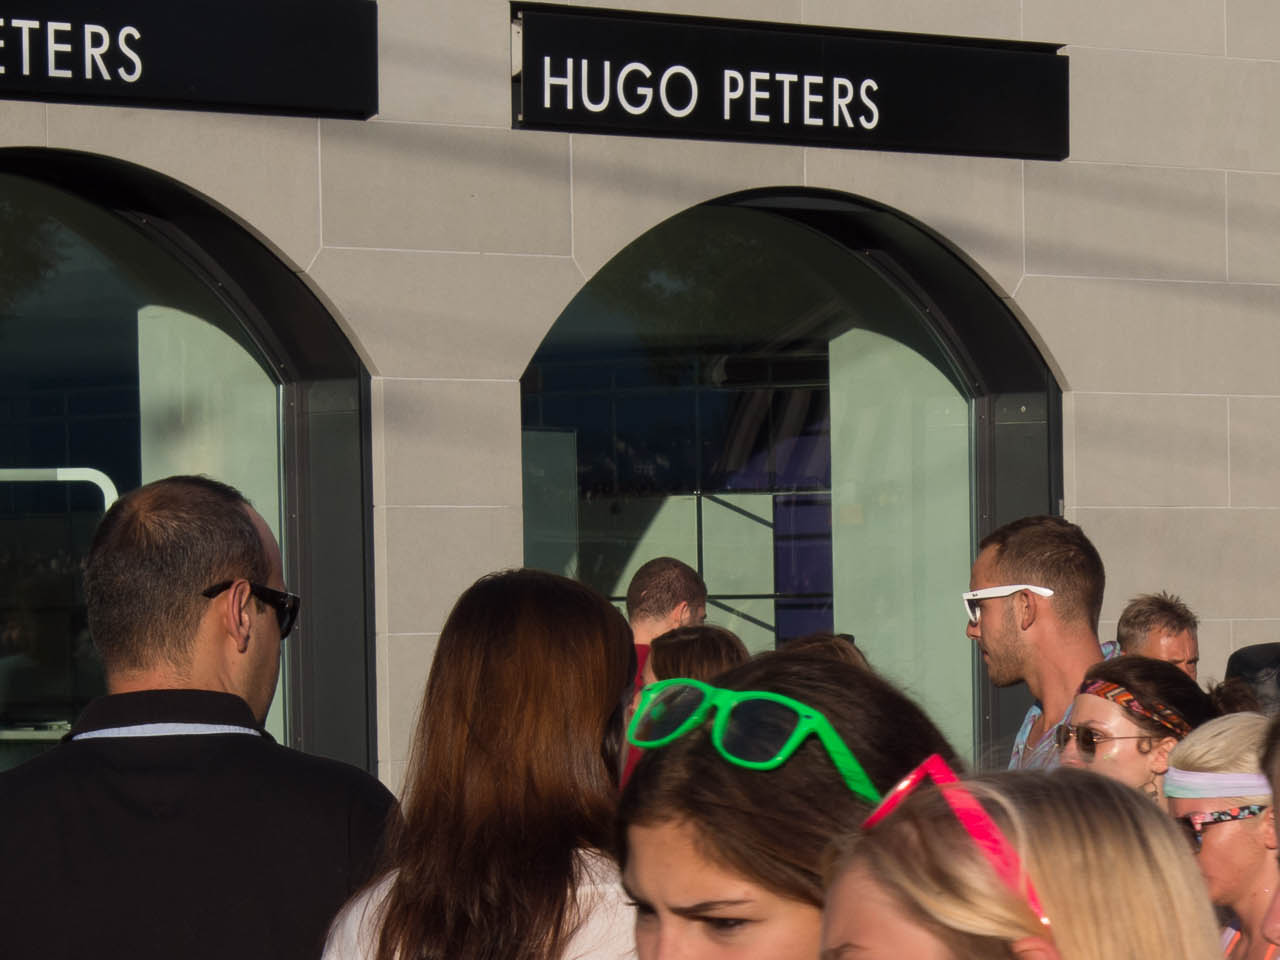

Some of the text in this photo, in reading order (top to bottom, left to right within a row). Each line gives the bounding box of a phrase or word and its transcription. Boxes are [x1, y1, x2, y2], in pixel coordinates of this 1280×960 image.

[0, 19, 142, 83] TERS
[544, 56, 879, 130] HUGO PETERS
